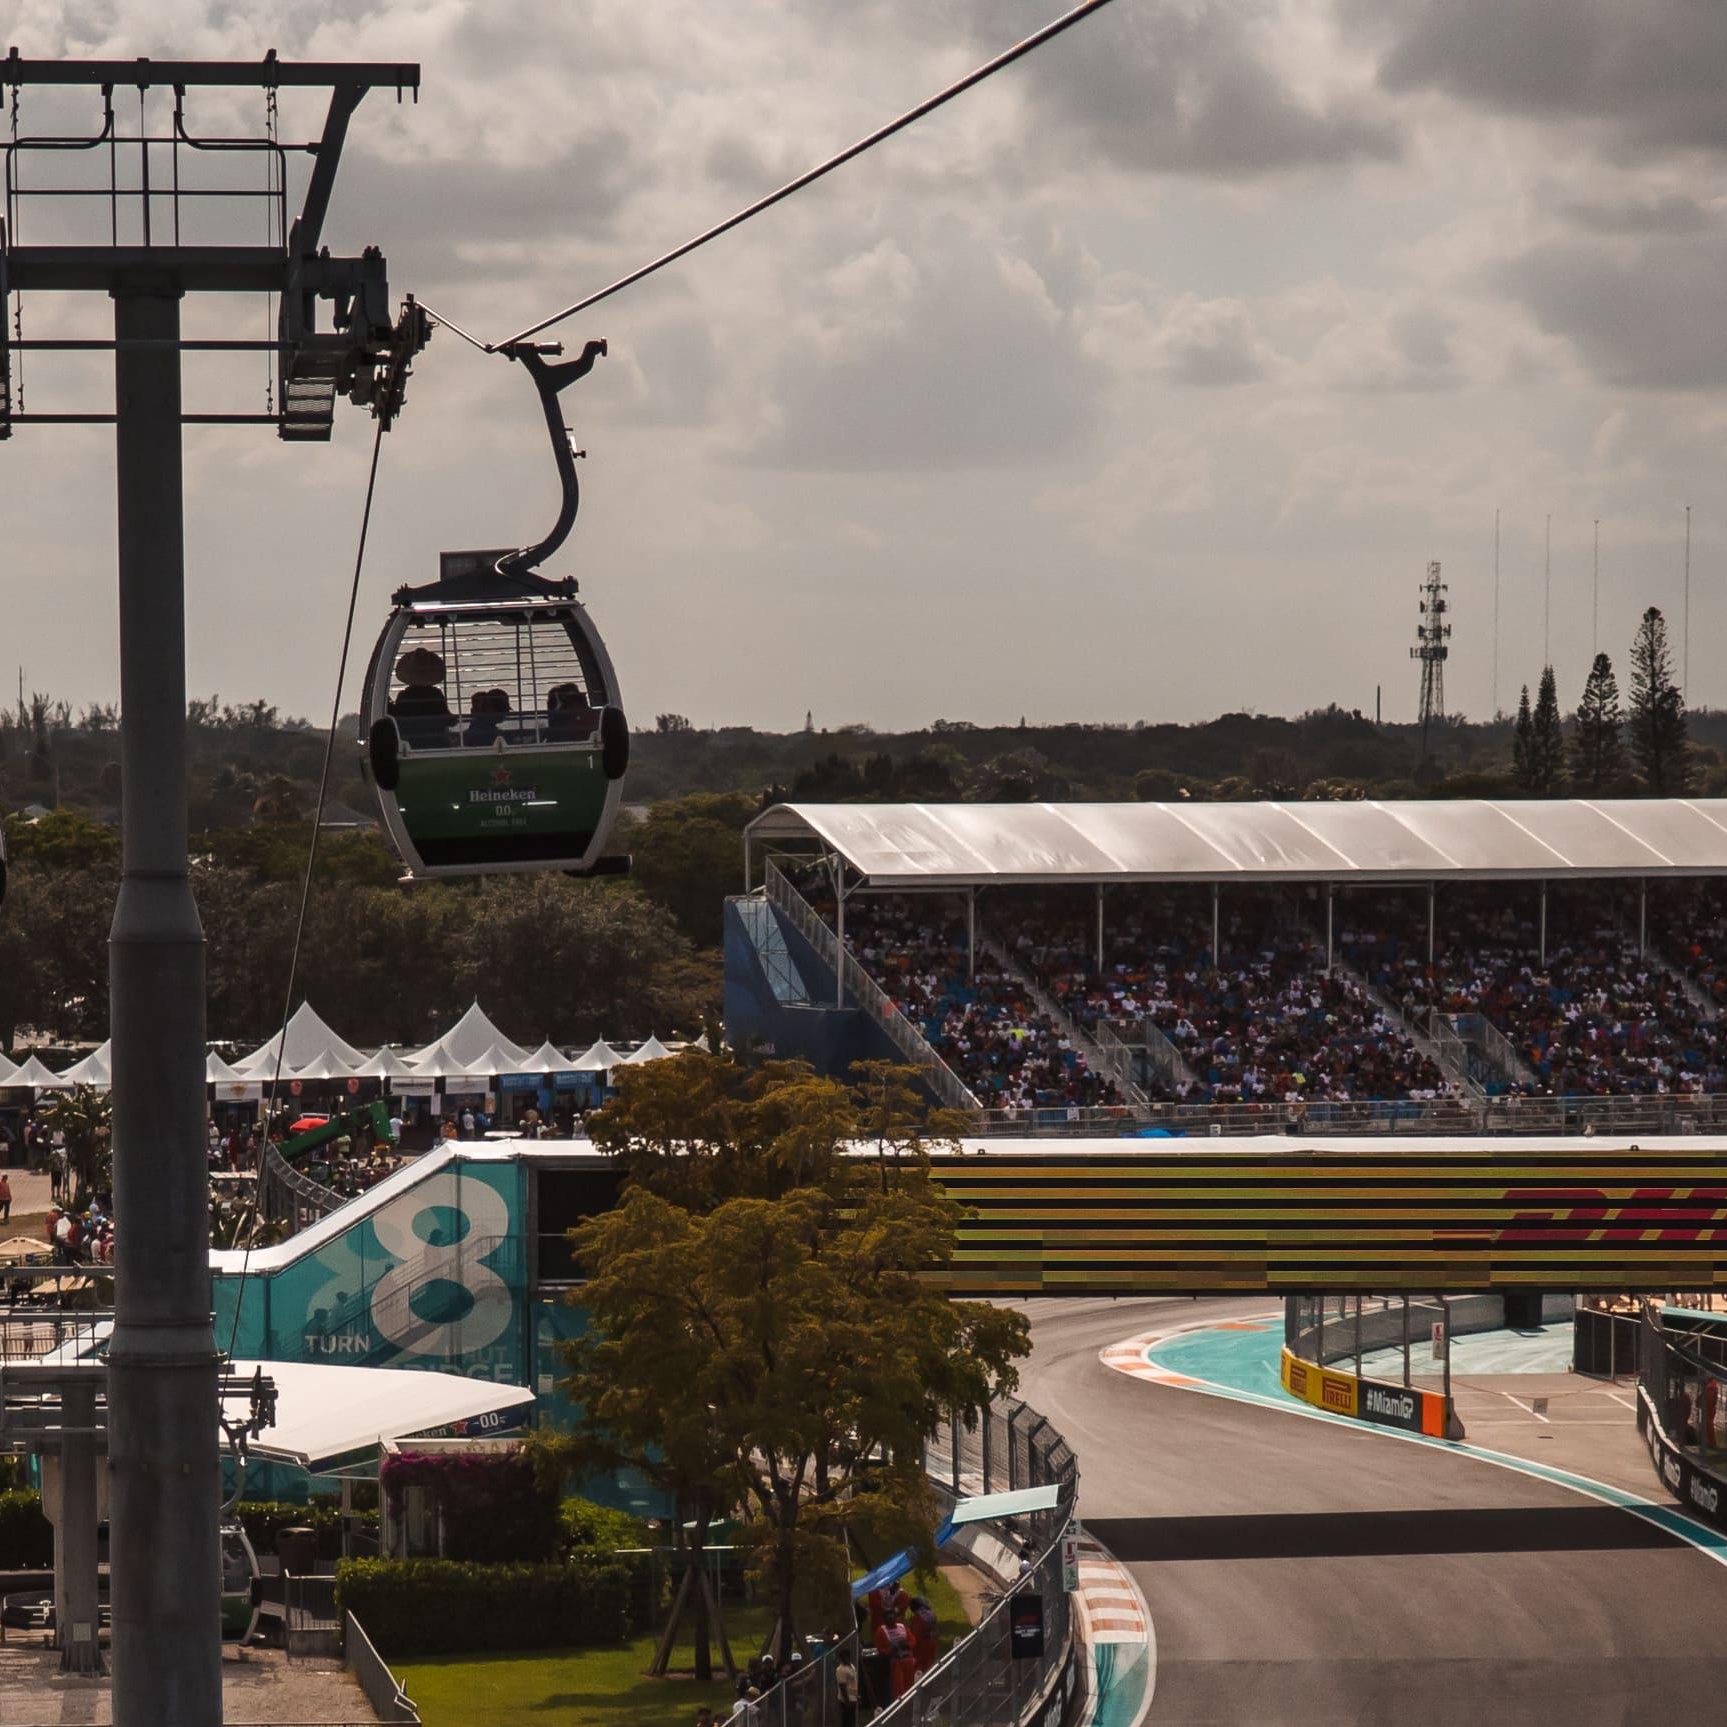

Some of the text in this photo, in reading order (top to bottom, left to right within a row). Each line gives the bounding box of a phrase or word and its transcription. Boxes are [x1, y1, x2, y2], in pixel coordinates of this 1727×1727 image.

[586, 755, 594, 769] 1
[469, 787, 537, 802] Heineken
[370, 1173, 513, 1356] 8
[305, 1335, 369, 1353] TURN
[1323, 1376, 1352, 1410] PIRELLI
[1367, 1391, 1413, 1419] #MiamiGP
[479, 1412, 500, 1428] 0.0
